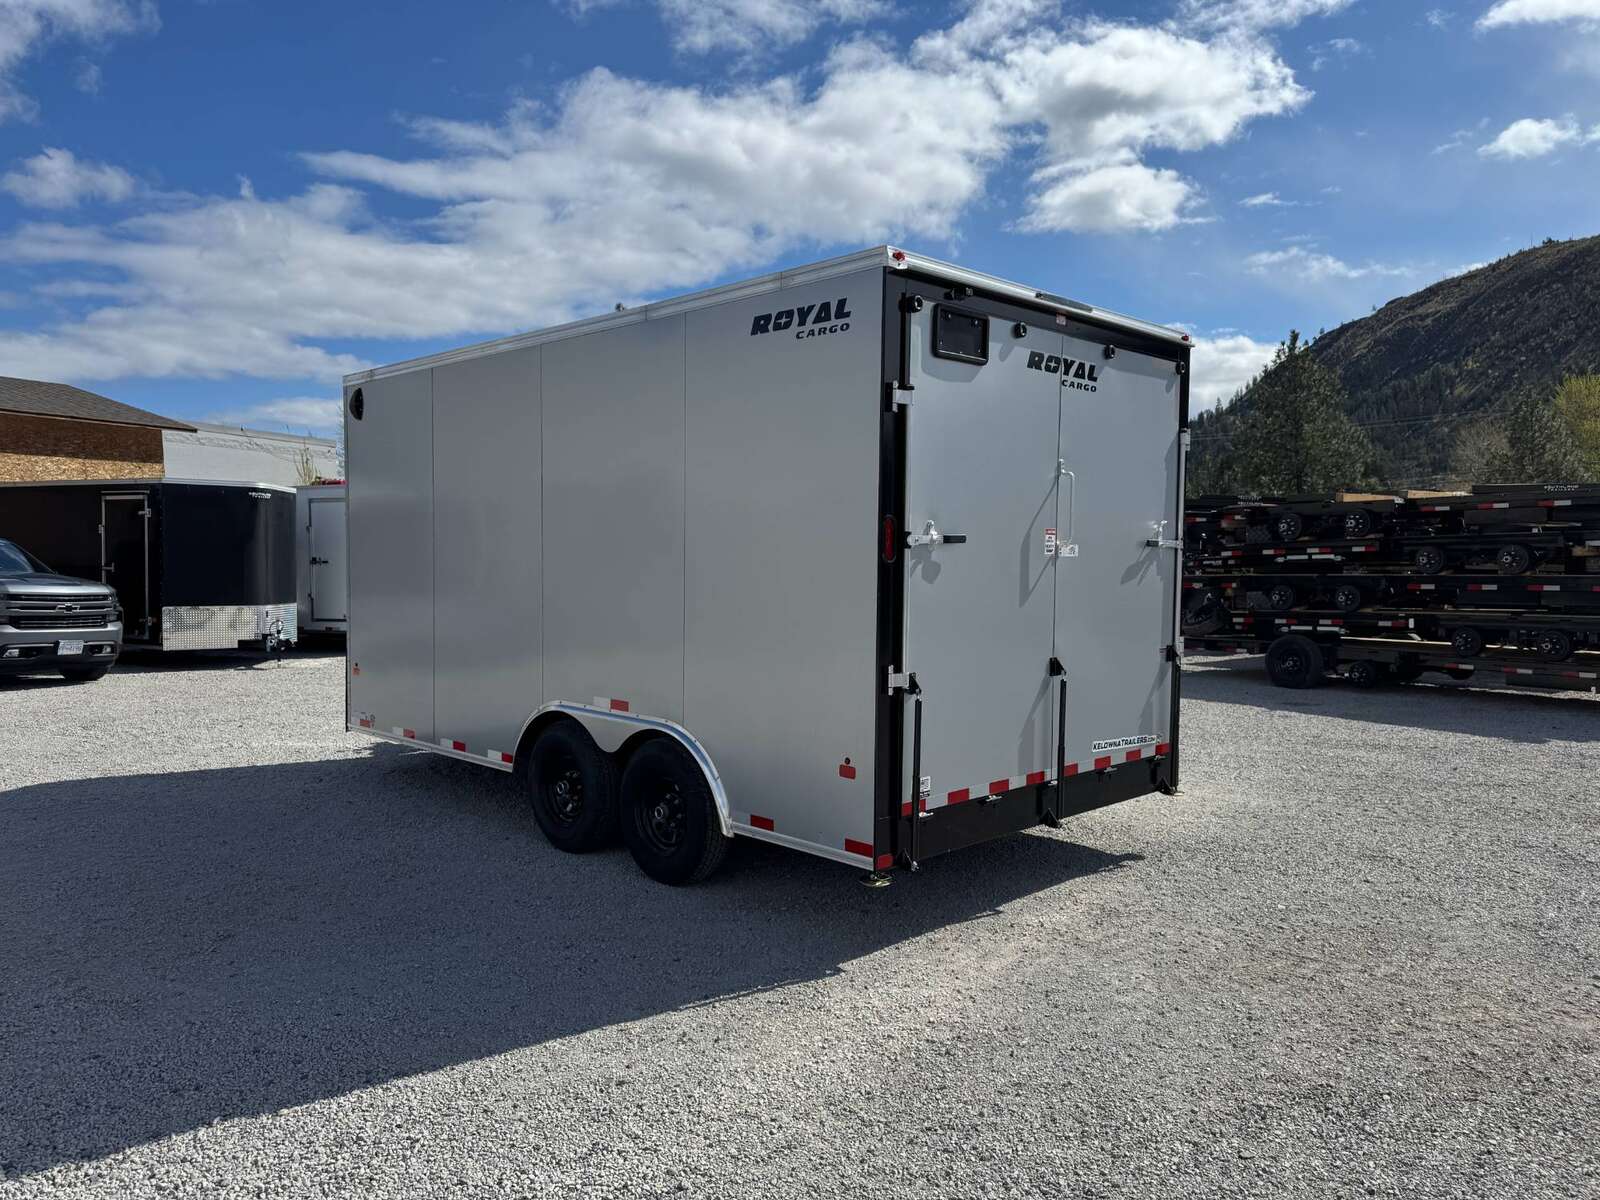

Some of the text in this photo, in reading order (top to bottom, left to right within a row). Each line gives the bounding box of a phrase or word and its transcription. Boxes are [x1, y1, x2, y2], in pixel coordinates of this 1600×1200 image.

[750, 297, 852, 336] ROYAL
[795, 322, 850, 340] CARGO
[1027, 350, 1098, 382] ROYAL
[1061, 379, 1097, 393] CARGO
